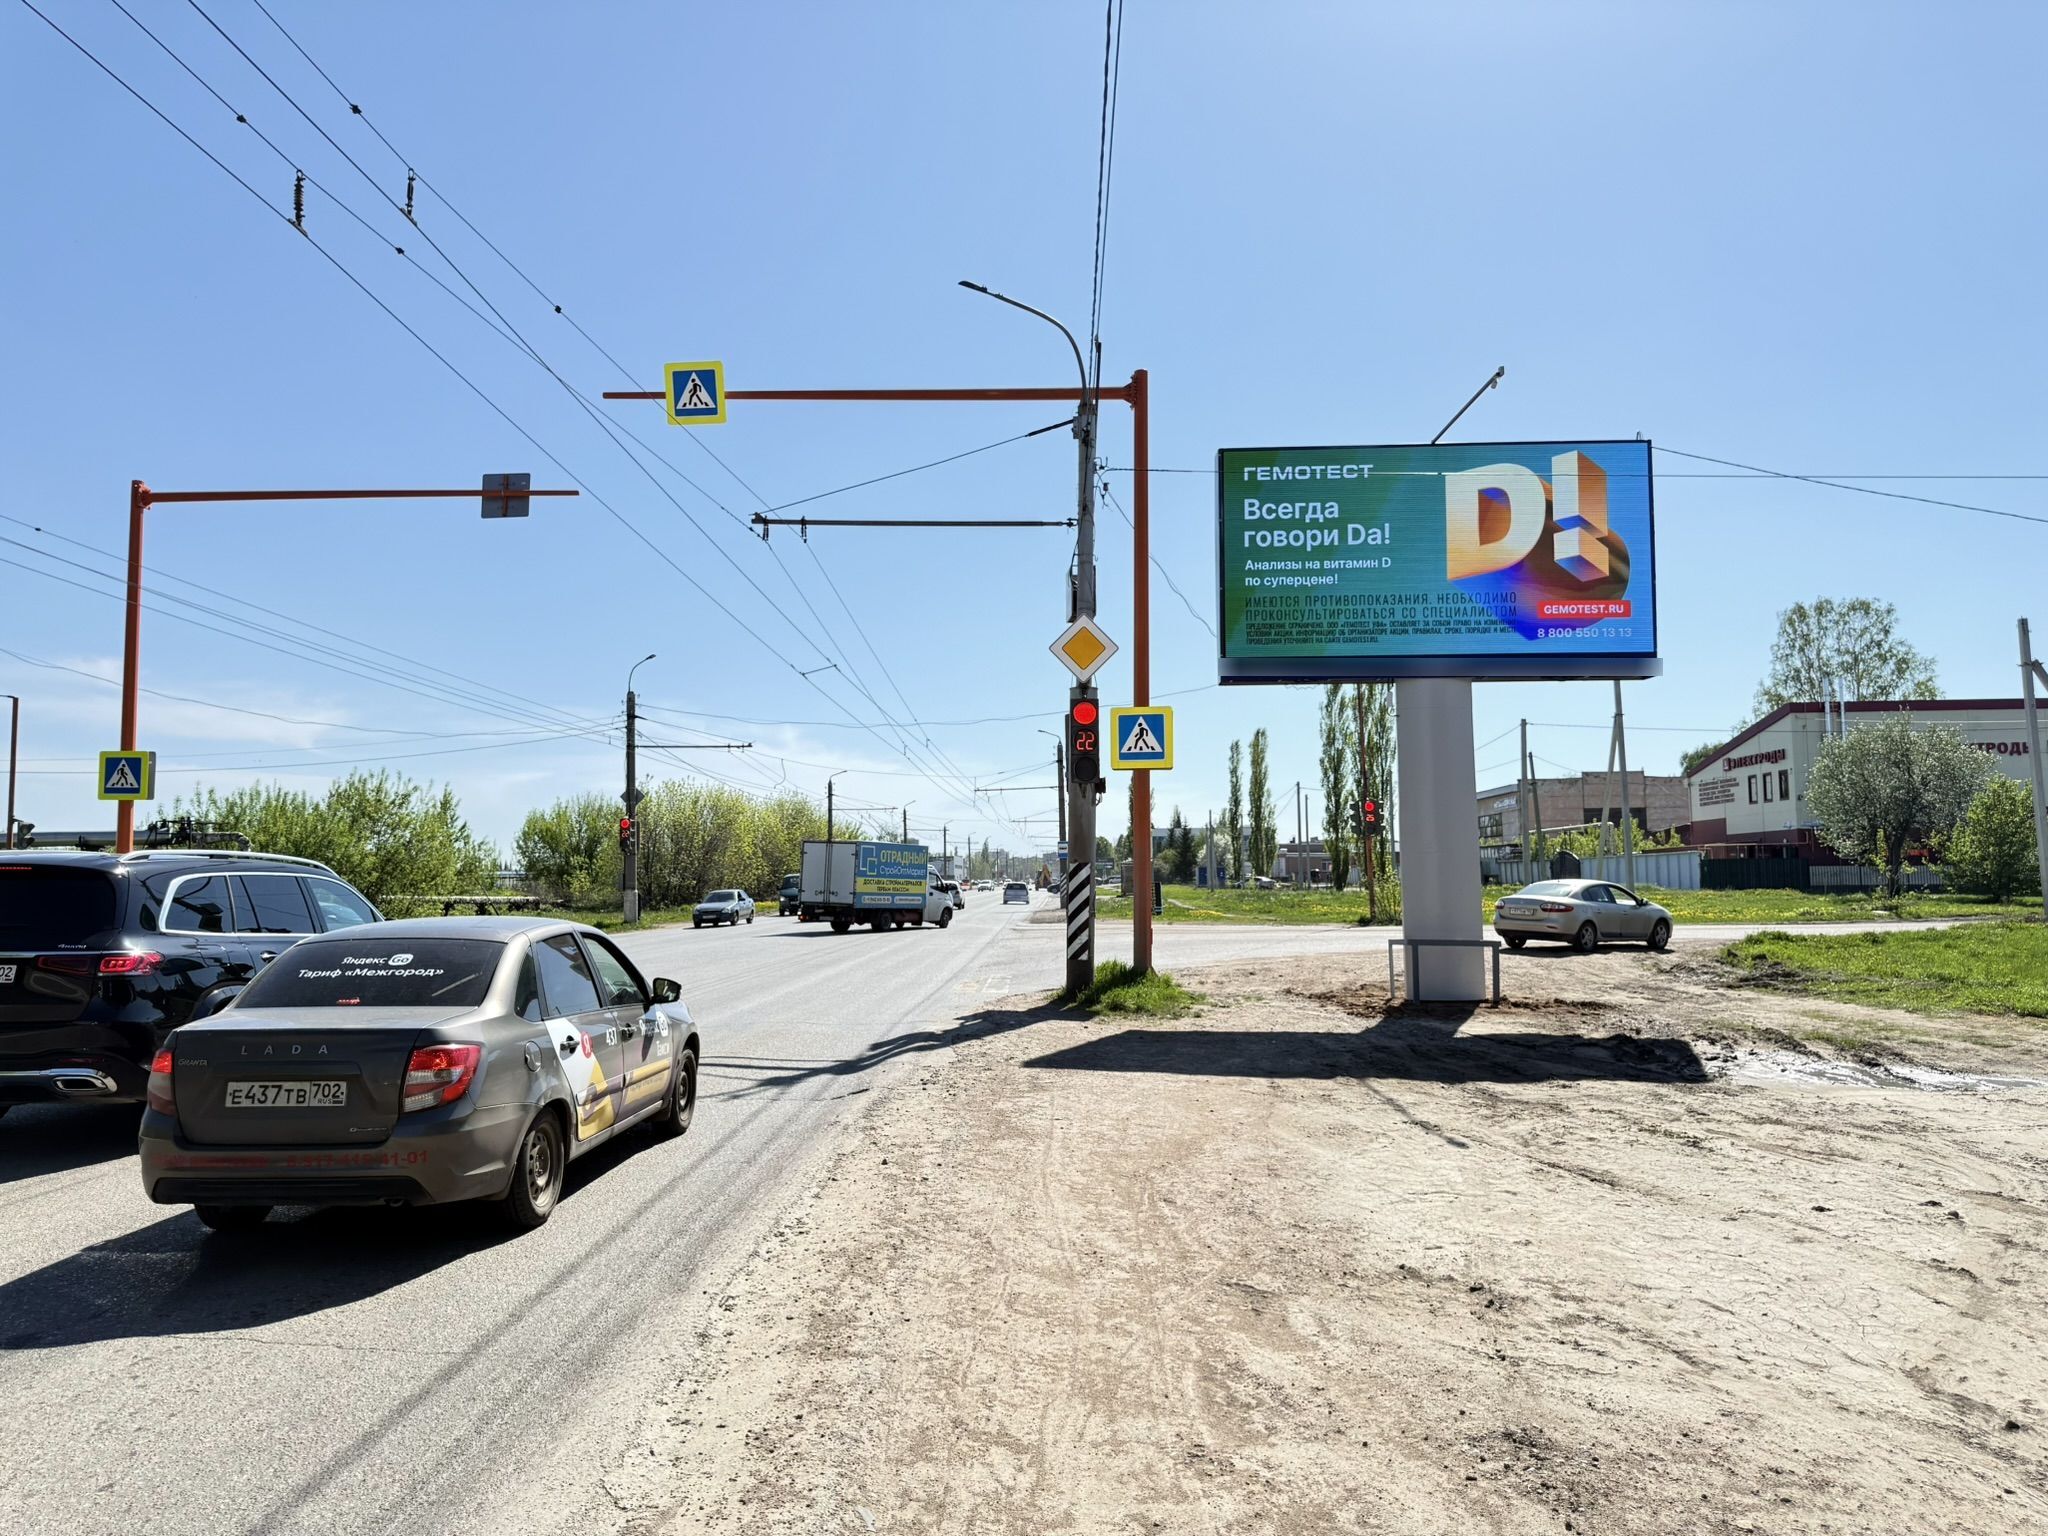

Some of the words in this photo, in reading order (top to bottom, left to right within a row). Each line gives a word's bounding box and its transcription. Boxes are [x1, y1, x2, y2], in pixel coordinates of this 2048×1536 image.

[1243, 464, 1374, 481] ГЕМОТЕСТ
[1244, 498, 1339, 523] Всегда
[1244, 528, 1339, 551] говори
[1347, 523, 1390, 545] Da!
[1245, 560, 1302, 571] Анализы
[1305, 561, 1320, 570] на
[1323, 559, 1378, 570] витамин
[1381, 557, 1392, 568] D
[1245, 576, 1261, 586] по
[1263, 573, 1339, 588] суперцене!
[1245, 595, 1300, 609] ИМЕЮТСЯ
[1305, 592, 1432, 607] ПРОТИВОПОКАЗАНИЯ.
[1437, 591, 1517, 604] НЕОБХОДИМО
[1245, 607, 1396, 622] ПРОКОНСУЛЬТИРОВАТЬСЯ
[1401, 606, 1416, 619] СО
[1422, 605, 1517, 619] СПЕЦИАЛИСТОМ
[1543, 605, 1625, 615] GEMOTEST.RU
[1537, 628, 1545, 638] 8
[1548, 628, 1573, 638] 800
[1575, 628, 1599, 638] 550
[1602, 628, 1616, 638] 13
[1619, 627, 1632, 638] 13
[1076, 731, 1096, 752] 22
[1731, 748, 1786, 770] ЭЛЕКТРОДЫ
[880, 849, 927, 865] ОТРАДНЫЙ
[341, 955, 388, 966] Яндекс
[298, 968, 343, 979] Тариф
[345, 967, 445, 978] «Межгород»
[606, 1027, 617, 1046] 437
[240, 1044, 328, 1055] LADA
[312, 1083, 341, 1098] 702
